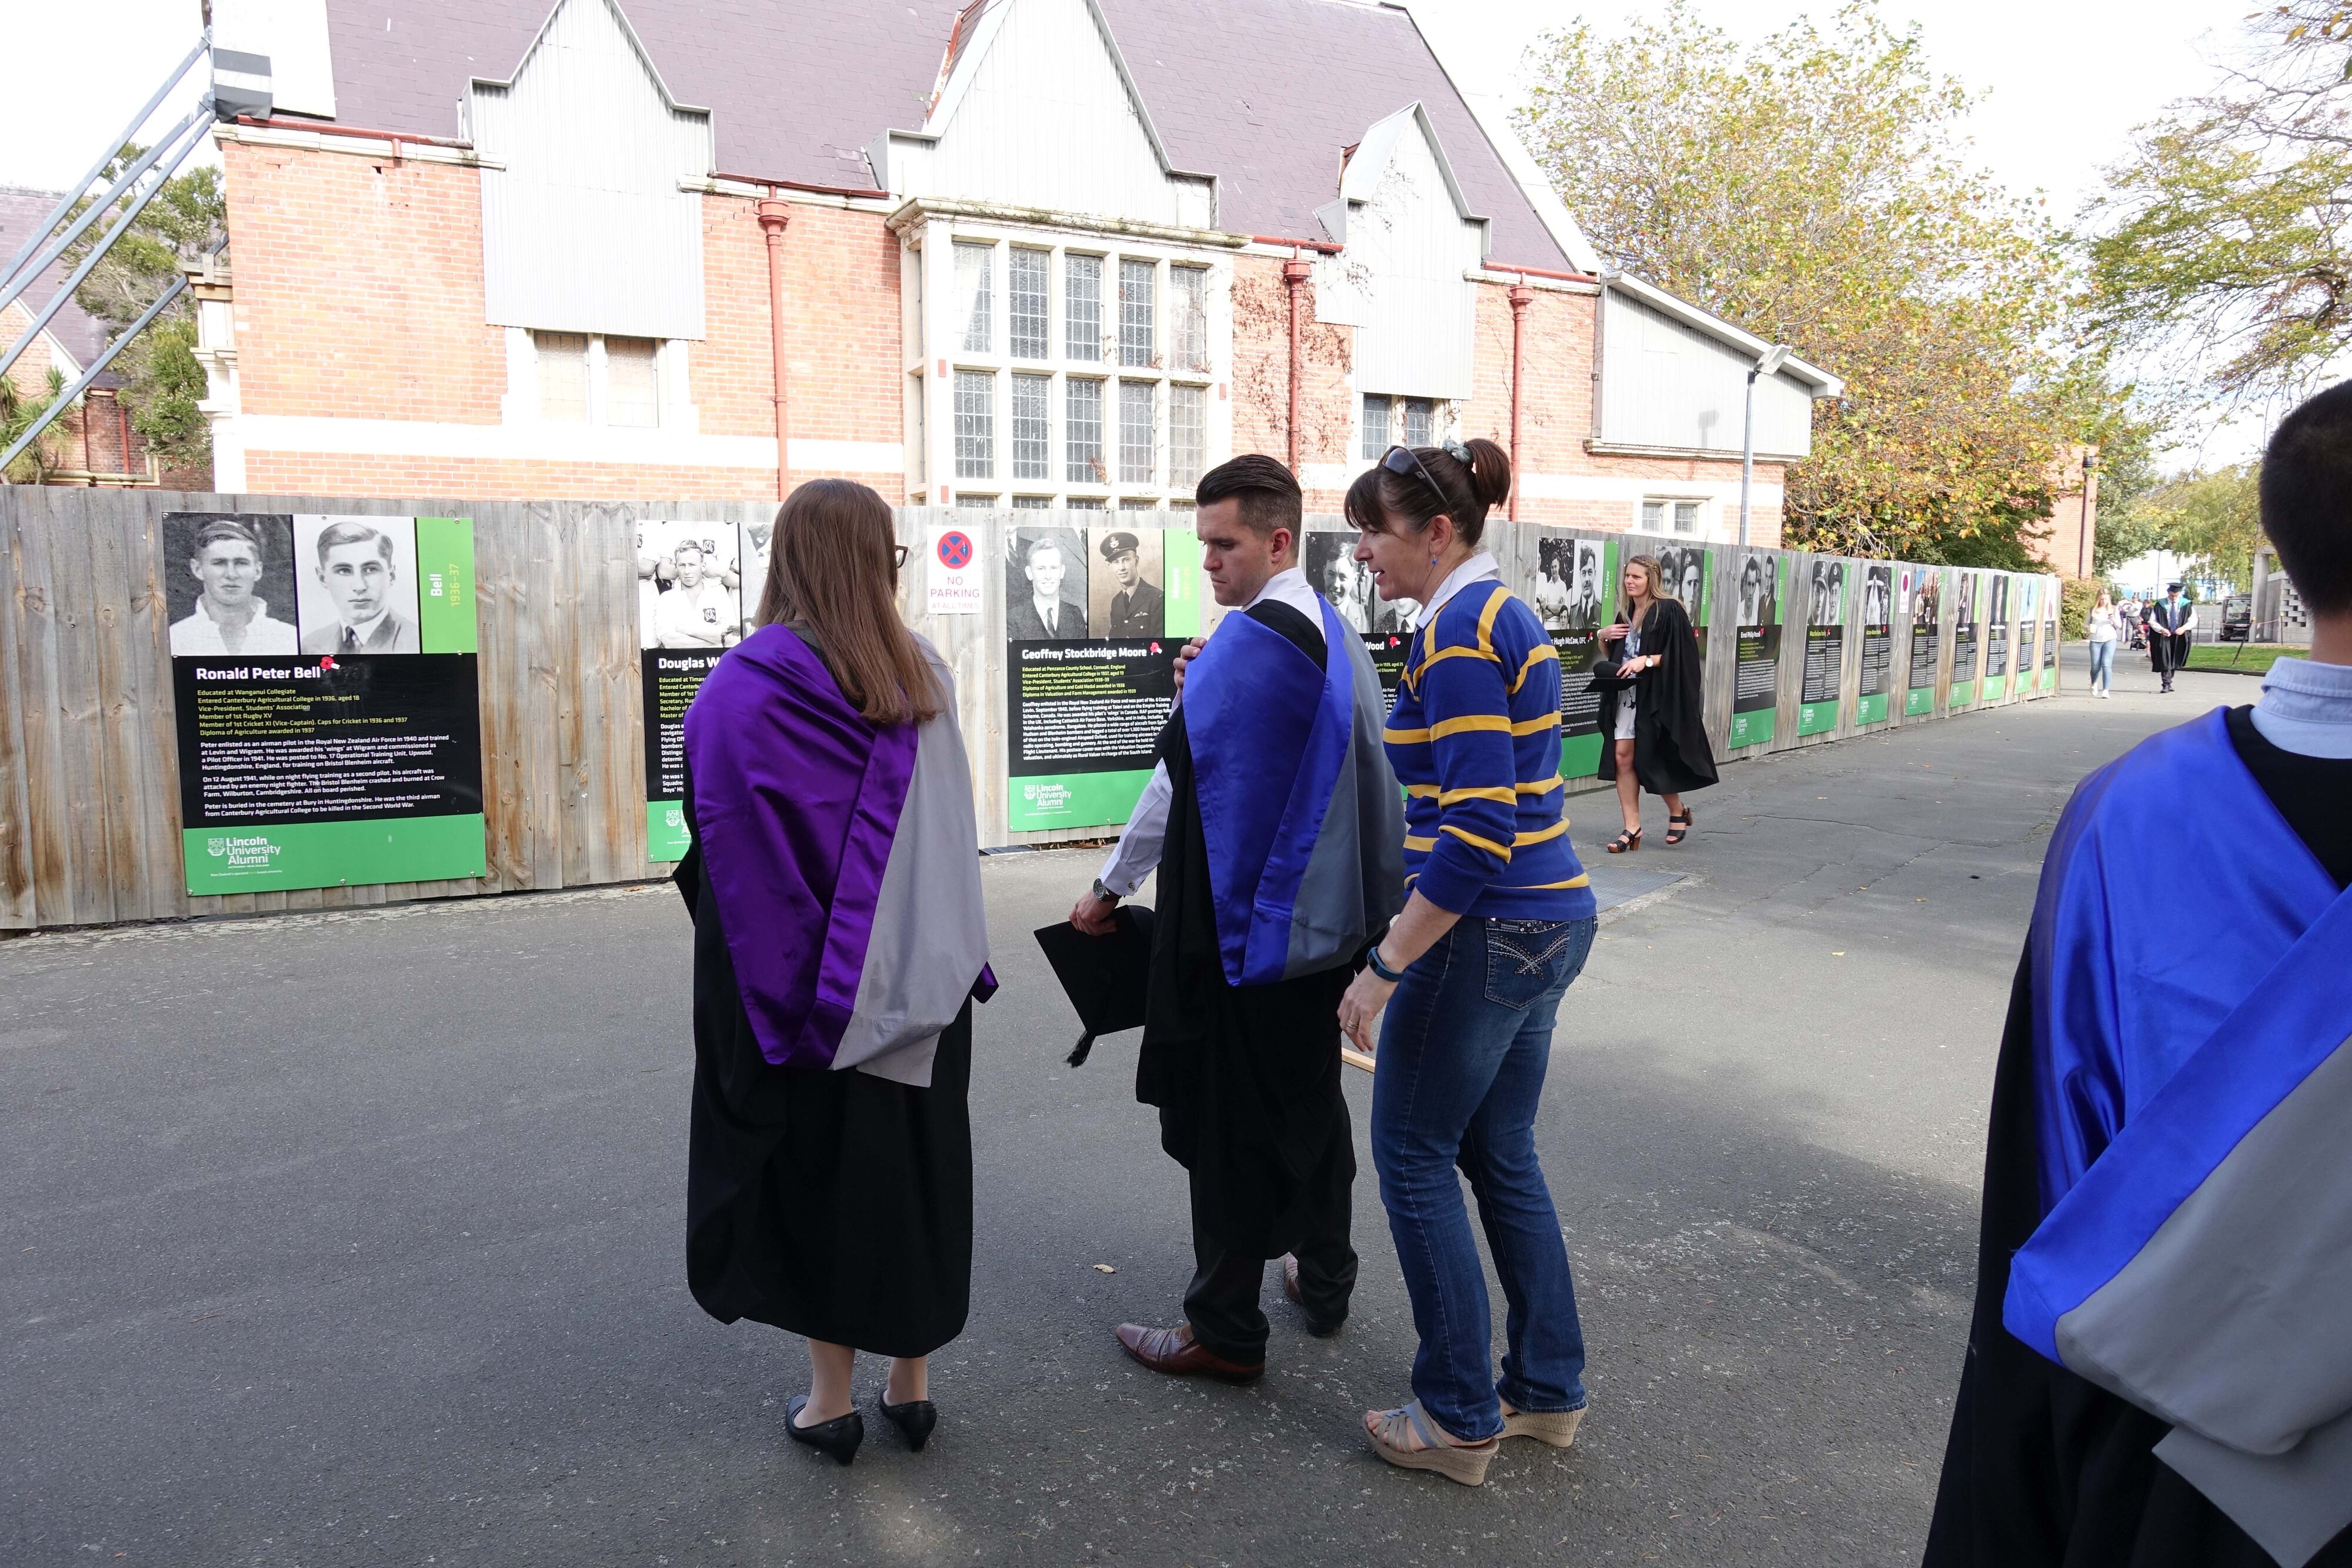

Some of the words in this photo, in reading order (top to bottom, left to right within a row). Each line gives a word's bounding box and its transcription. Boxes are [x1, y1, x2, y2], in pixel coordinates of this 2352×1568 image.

[429, 573, 442, 596] Bell
[449, 563, 461, 607] 1936-37
[948, 576, 963, 585] NO
[1171, 568, 1180, 599] Moore
[930, 589, 980, 598] PARKING
[1365, 641, 1384, 650] Wood
[1554, 636, 1564, 647] Hugh
[1565, 636, 1579, 645] McCaw,
[1022, 648, 1064, 661] Geoffrey
[1065, 647, 1117, 660] Stockbridge
[1118, 647, 1147, 658] Moore
[658, 657, 705, 671] Douglas
[196, 667, 249, 680] Ronald
[252, 667, 291, 679] Peter
[293, 666, 321, 679] Bell
[1036, 783, 1063, 792] Lincoln
[1036, 790, 1072, 799] University
[1037, 798, 1063, 806] Alumni
[226, 836, 267, 846] Lincoln
[227, 845, 281, 856] University
[228, 854, 268, 865] Alumni
